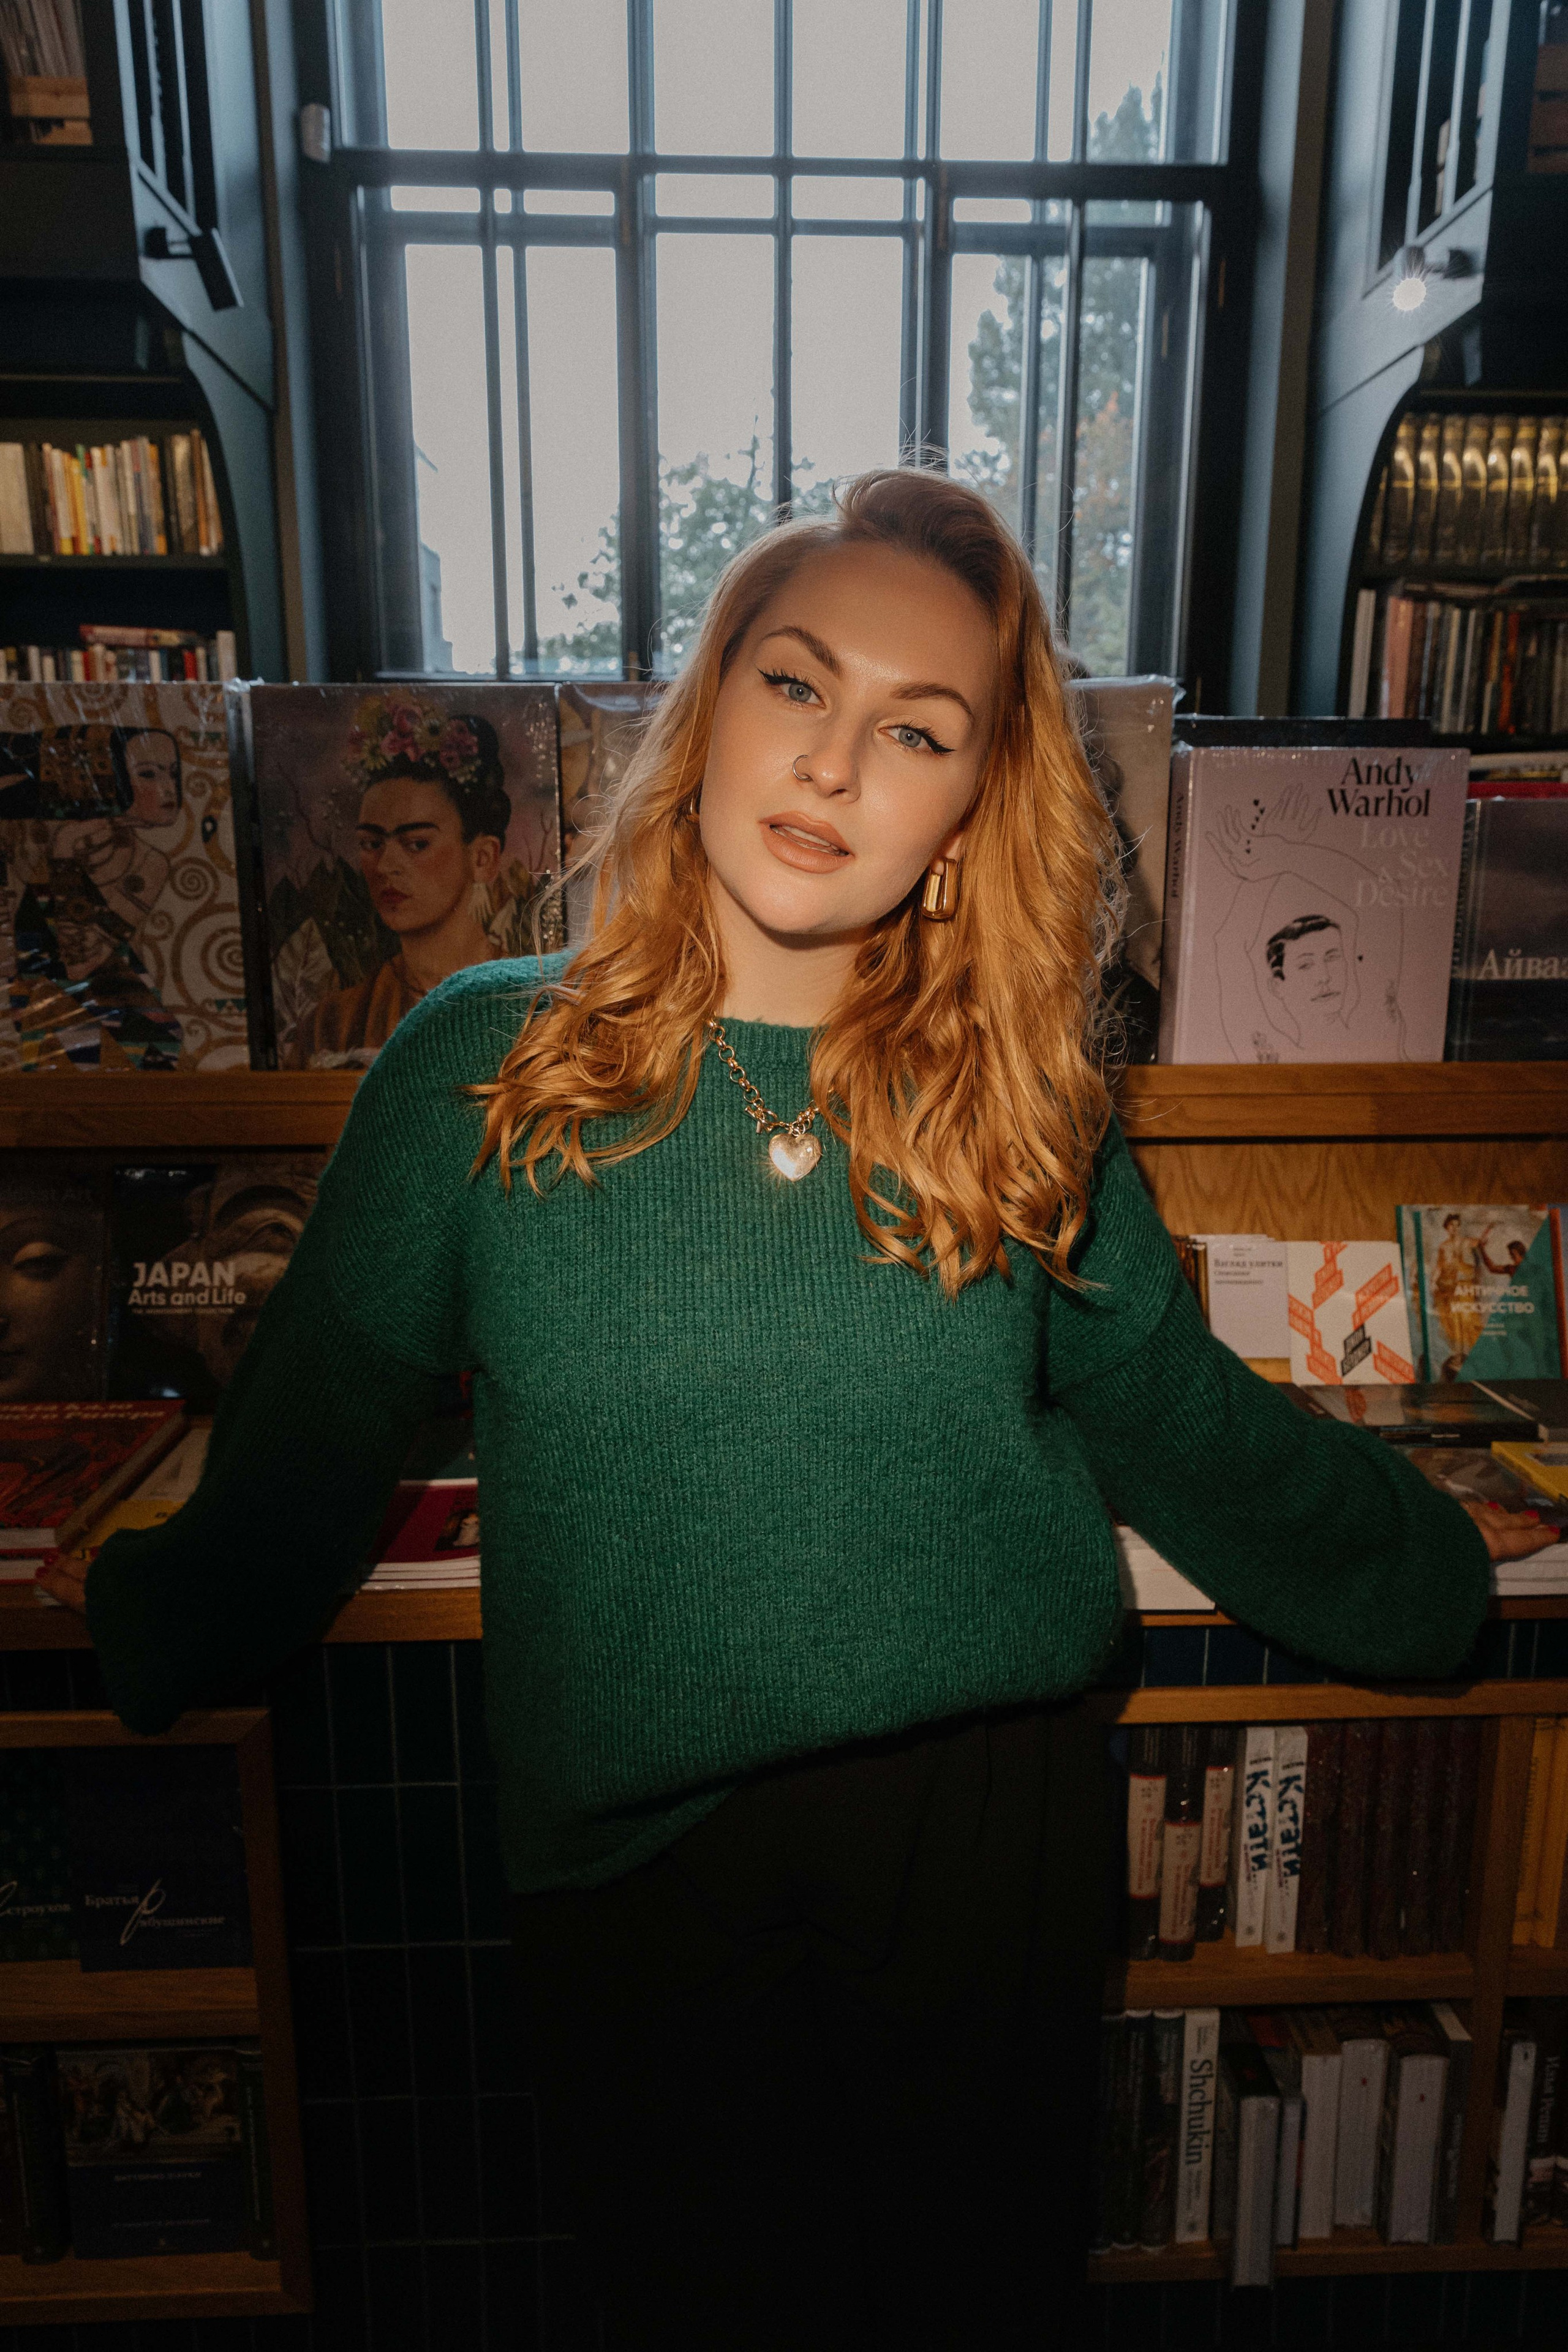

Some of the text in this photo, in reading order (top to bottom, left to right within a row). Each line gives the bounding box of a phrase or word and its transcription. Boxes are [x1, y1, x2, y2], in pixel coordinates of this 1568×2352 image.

[1341, 756, 1417, 793] Andy
[1327, 788, 1431, 817] Warhol
[1170, 791, 1185, 899] Andy Warhol
[1362, 820, 1429, 849] Love
[1398, 851, 1449, 880] Sex
[1355, 880, 1449, 907] Desire
[132, 1261, 236, 1288] JAPAN
[127, 1287, 247, 1306] Arts and Life
[85, 1893, 140, 1909] Братья
[1185, 2059, 1214, 2166] Shchukin
